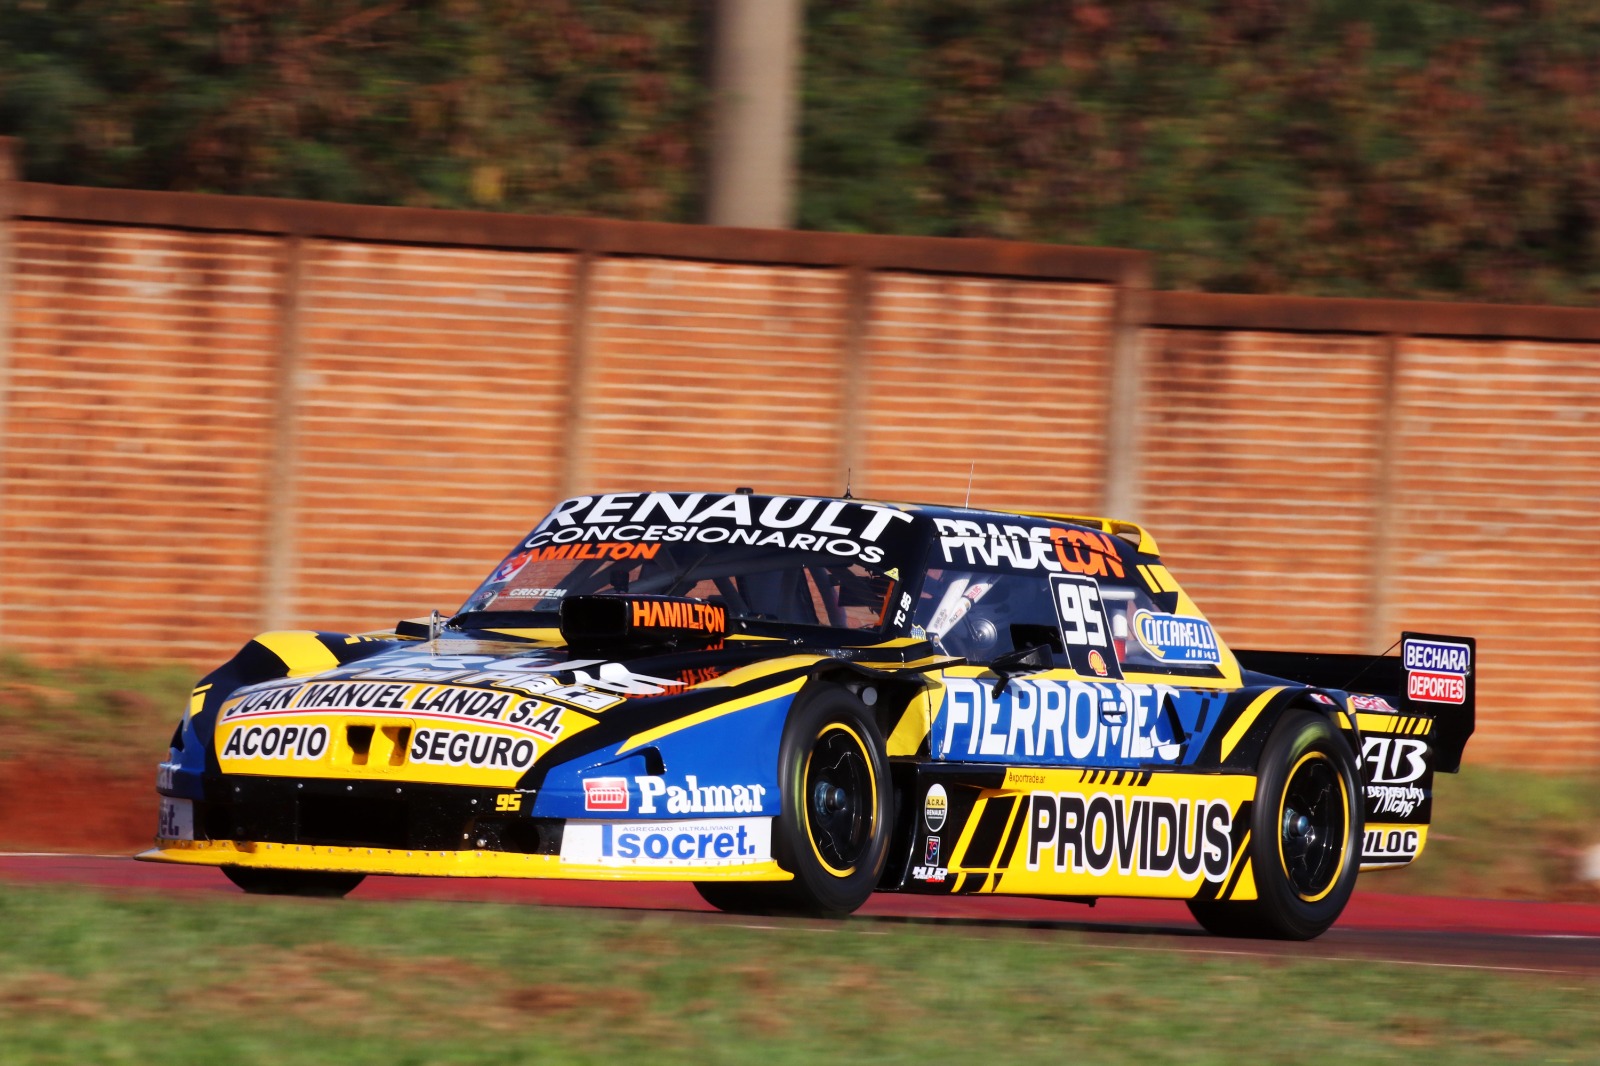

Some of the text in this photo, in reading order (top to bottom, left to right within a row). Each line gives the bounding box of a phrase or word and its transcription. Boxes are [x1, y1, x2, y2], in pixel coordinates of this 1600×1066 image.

[535, 492, 914, 542] RENAULT
[525, 524, 885, 563] CONCESIONARIOS
[933, 518, 1125, 579] PRADECON
[509, 588, 568, 598] CRISTEM
[893, 591, 912, 628] TC 95
[631, 600, 725, 634] HAMILTON
[1058, 583, 1108, 648] 95
[1144, 619, 1215, 650] CICCARELLI
[1406, 645, 1467, 671] BECHARA
[1410, 676, 1464, 700] DEPORTES
[225, 684, 303, 717] JUAN
[297, 683, 414, 709] MANUEL
[411, 686, 502, 721] LANDA
[508, 699, 564, 735] S.A.
[942, 678, 1181, 761] FIERROMEC
[224, 726, 328, 757] ACOPIO
[411, 729, 535, 768] SEGURO
[495, 794, 522, 812] 95
[634, 775, 766, 814] Palmar
[601, 824, 756, 860] Isocret.
[1028, 794, 1233, 875] PROVIDUS
[1361, 831, 1418, 853] ILOC
